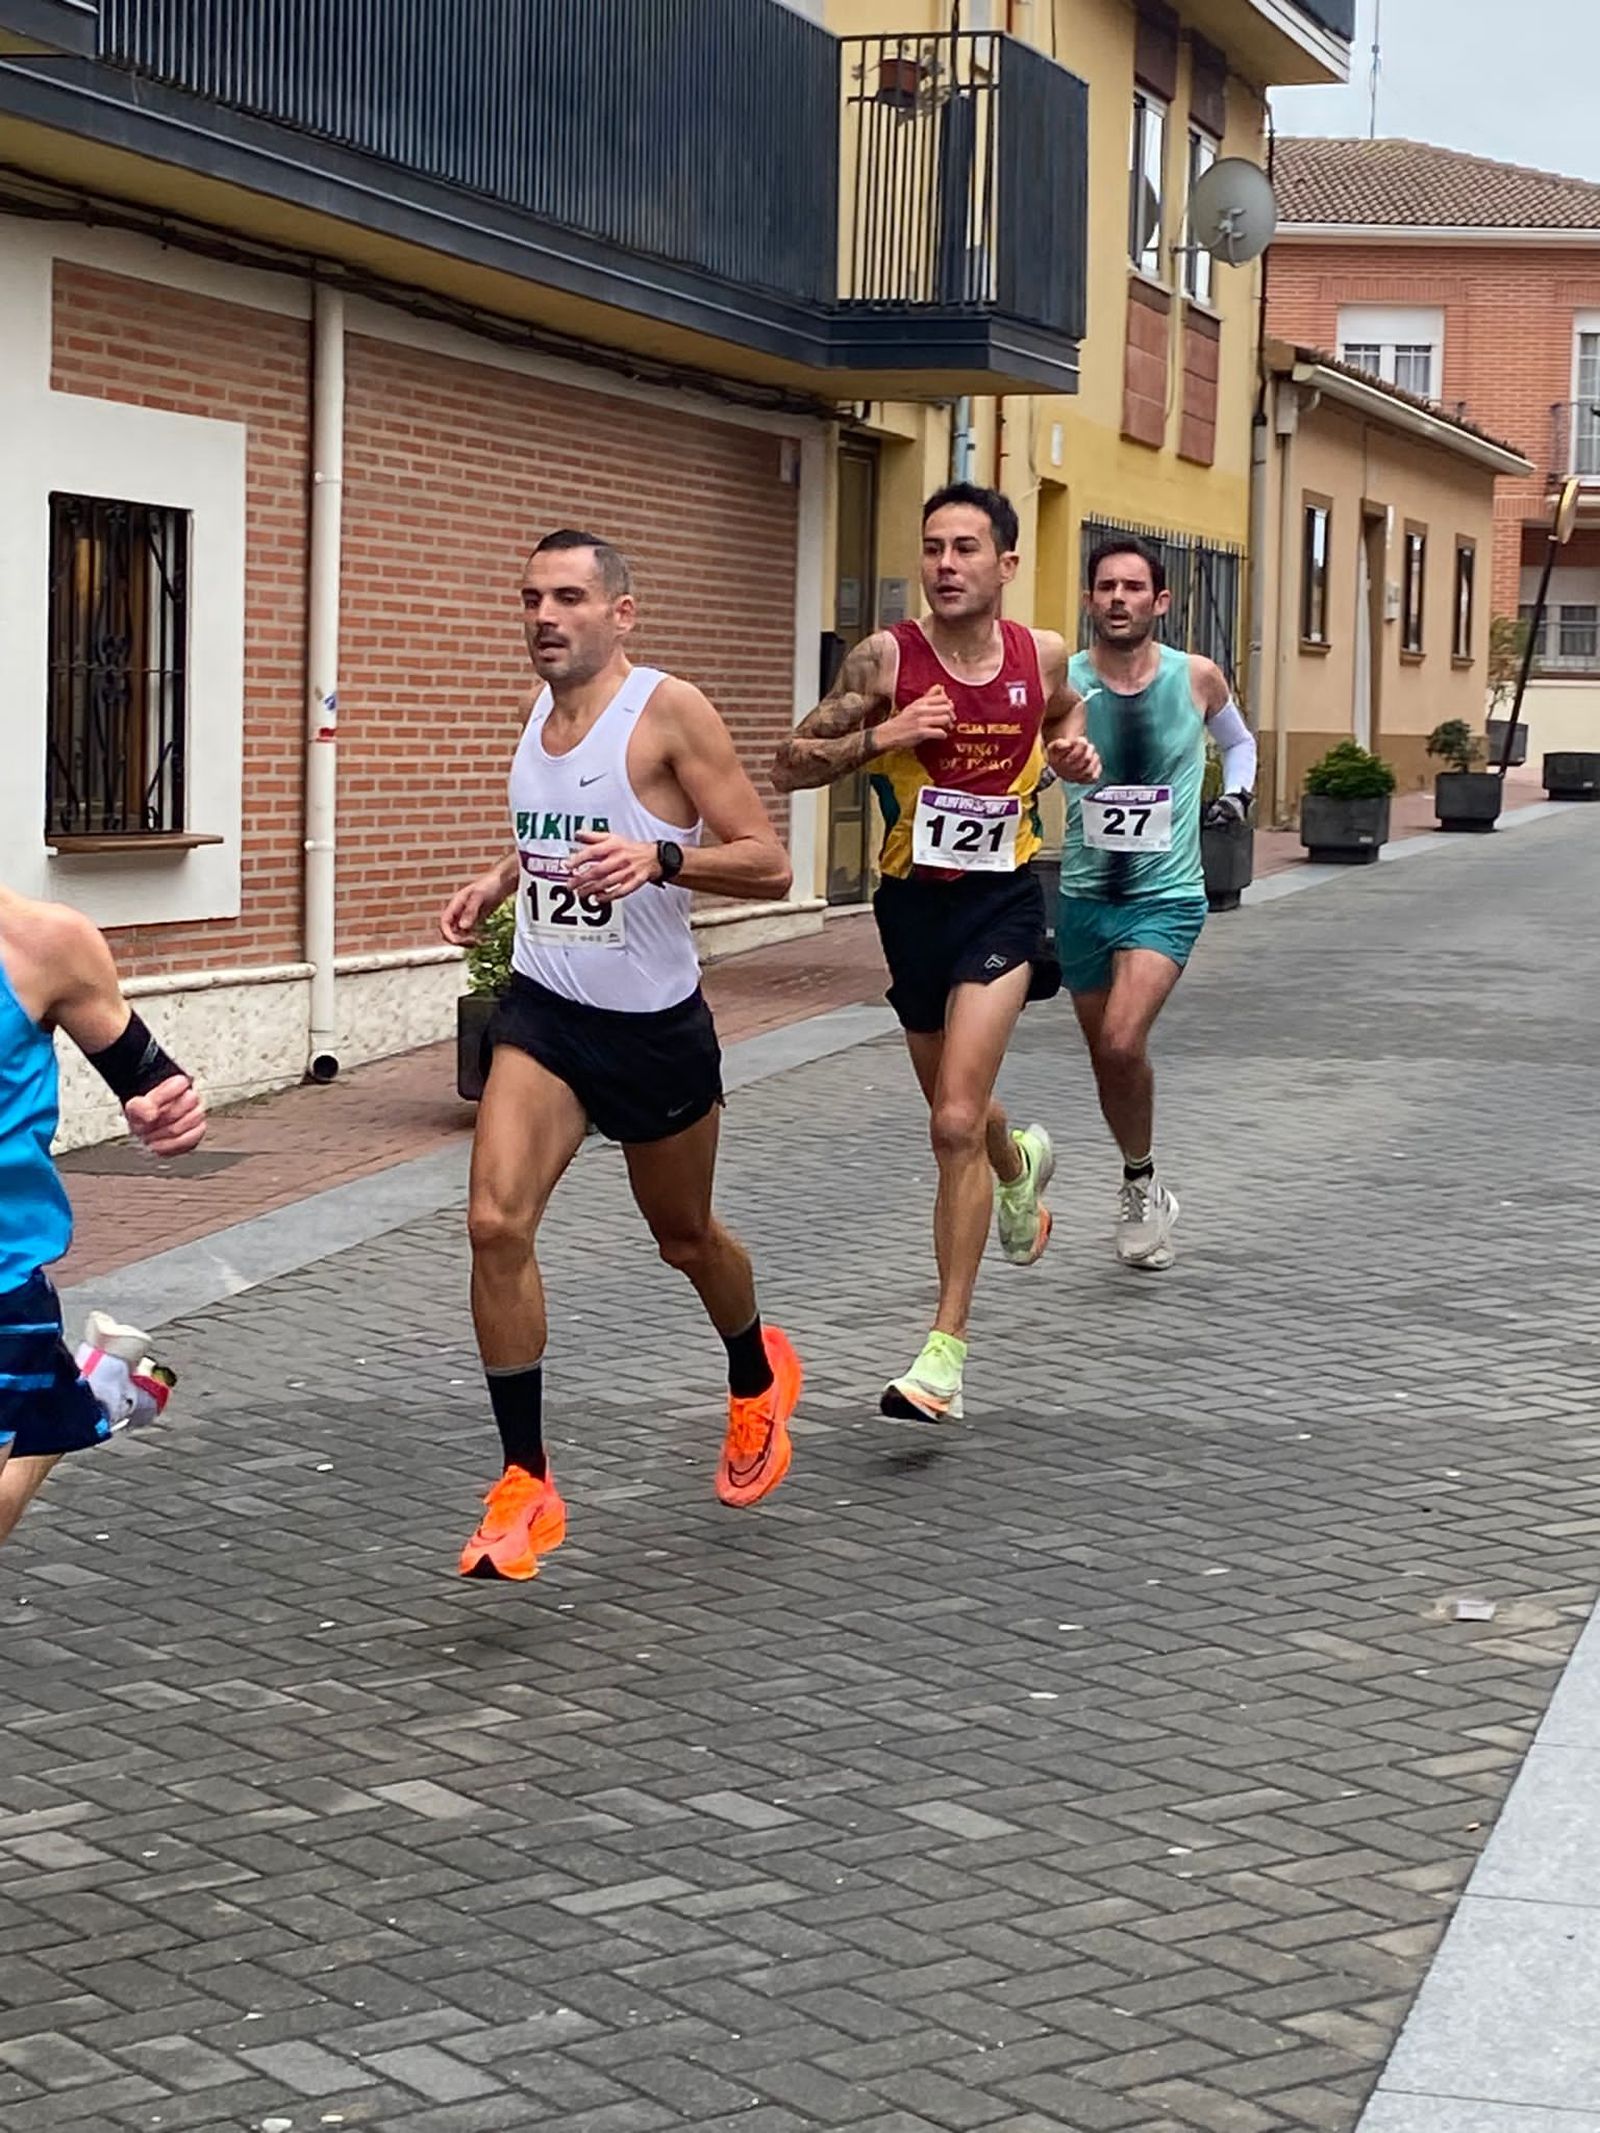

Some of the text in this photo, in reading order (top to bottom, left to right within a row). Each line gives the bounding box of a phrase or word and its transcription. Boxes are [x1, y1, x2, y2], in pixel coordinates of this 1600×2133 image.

[926, 815, 1006, 852] 121
[1103, 808, 1151, 836] 27
[527, 881, 613, 927] 129
